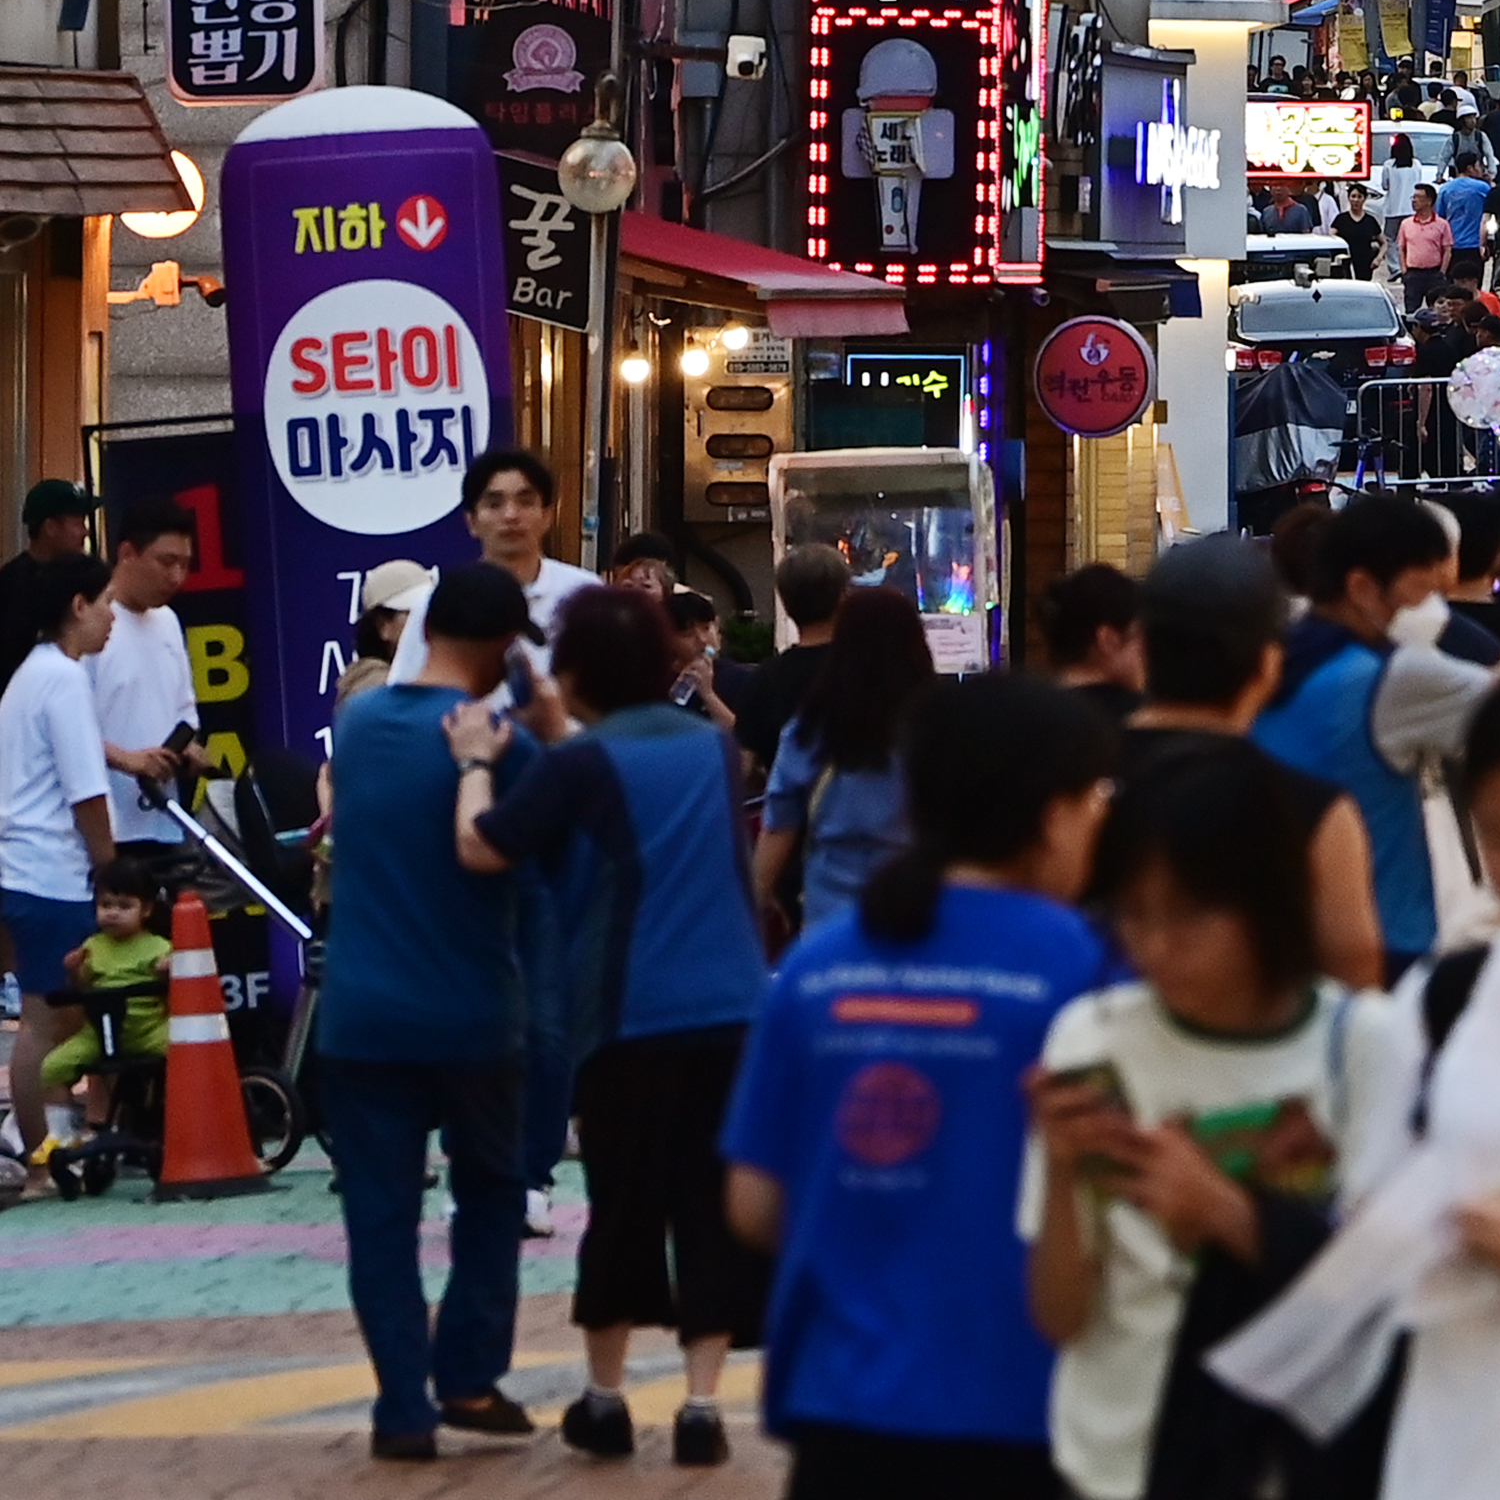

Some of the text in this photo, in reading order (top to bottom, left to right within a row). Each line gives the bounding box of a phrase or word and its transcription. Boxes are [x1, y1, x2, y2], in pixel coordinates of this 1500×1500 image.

[187, 28, 299, 87] 뽑기
[293, 202, 386, 254] 지하
[512, 276, 574, 310] Bar
[289, 323, 462, 394] S타이
[286, 406, 473, 478] 마사지
